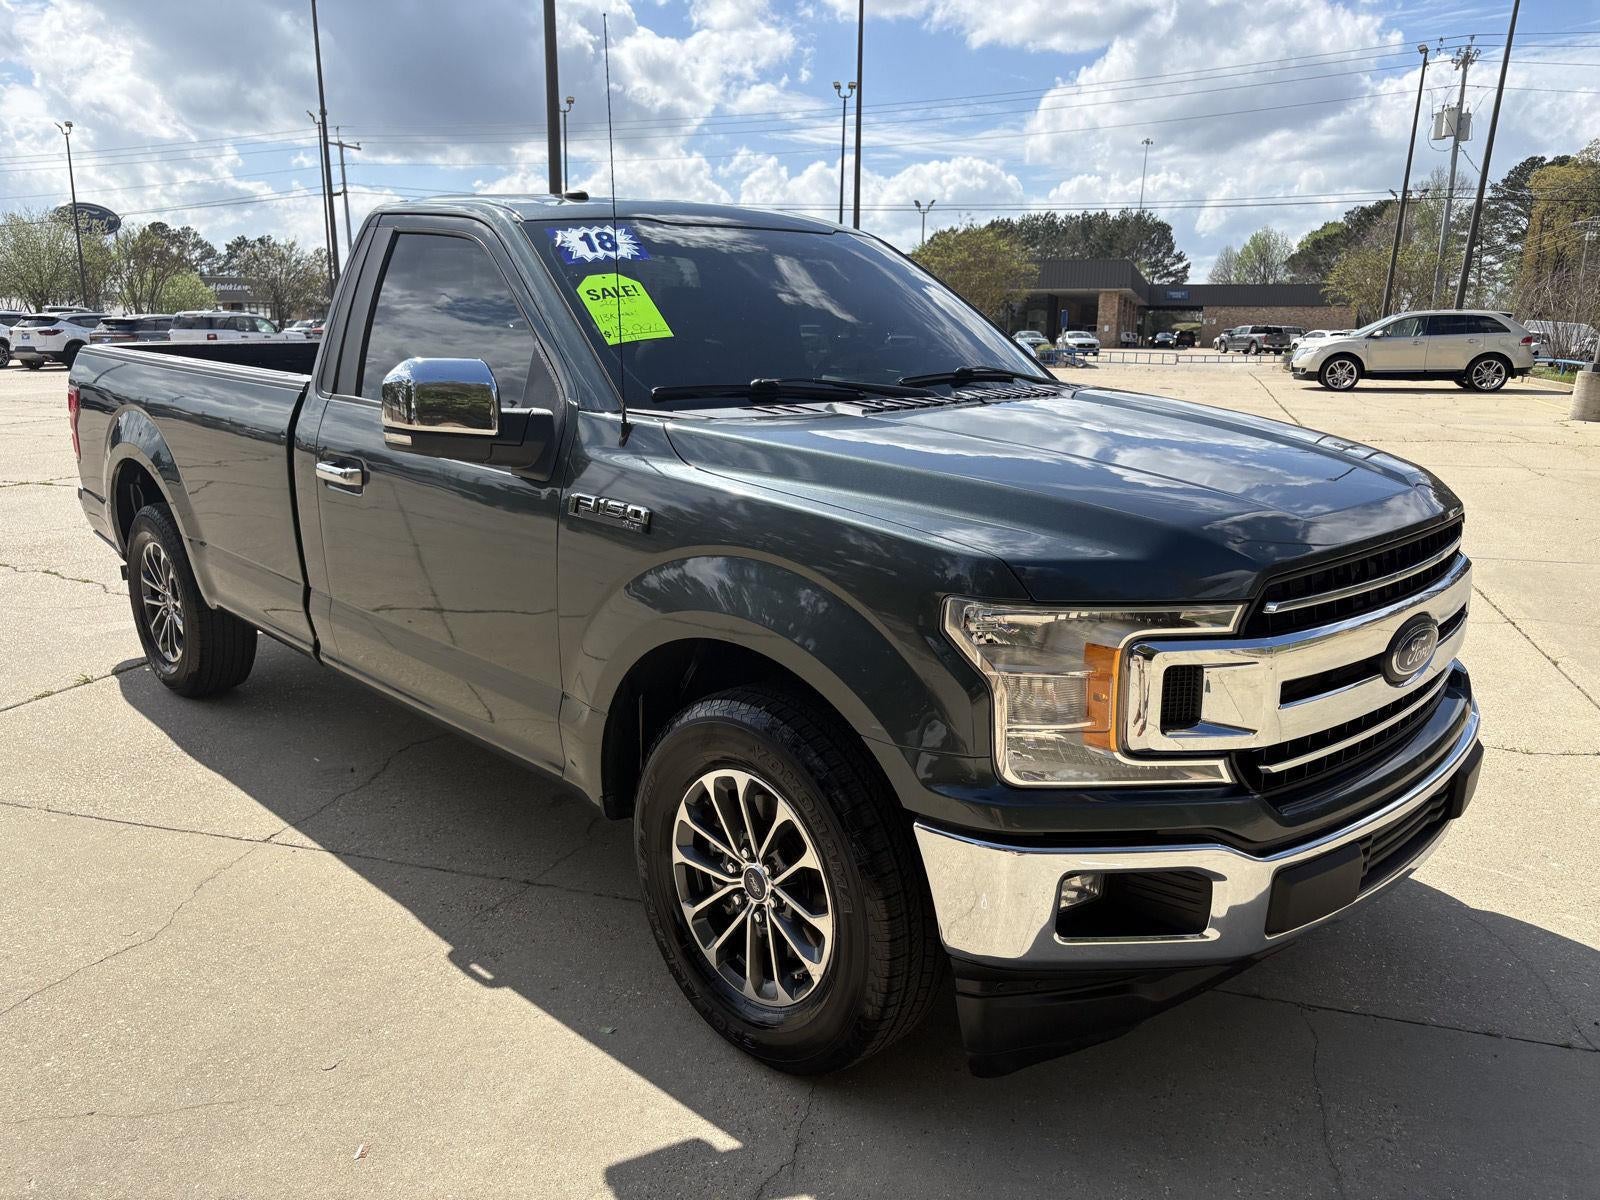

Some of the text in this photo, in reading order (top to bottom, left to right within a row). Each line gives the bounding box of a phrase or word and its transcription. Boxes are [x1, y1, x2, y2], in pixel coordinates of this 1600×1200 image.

[579, 231, 619, 253] 18
[586, 285, 640, 301] SALE!
[1406, 634, 1433, 666] Ford
